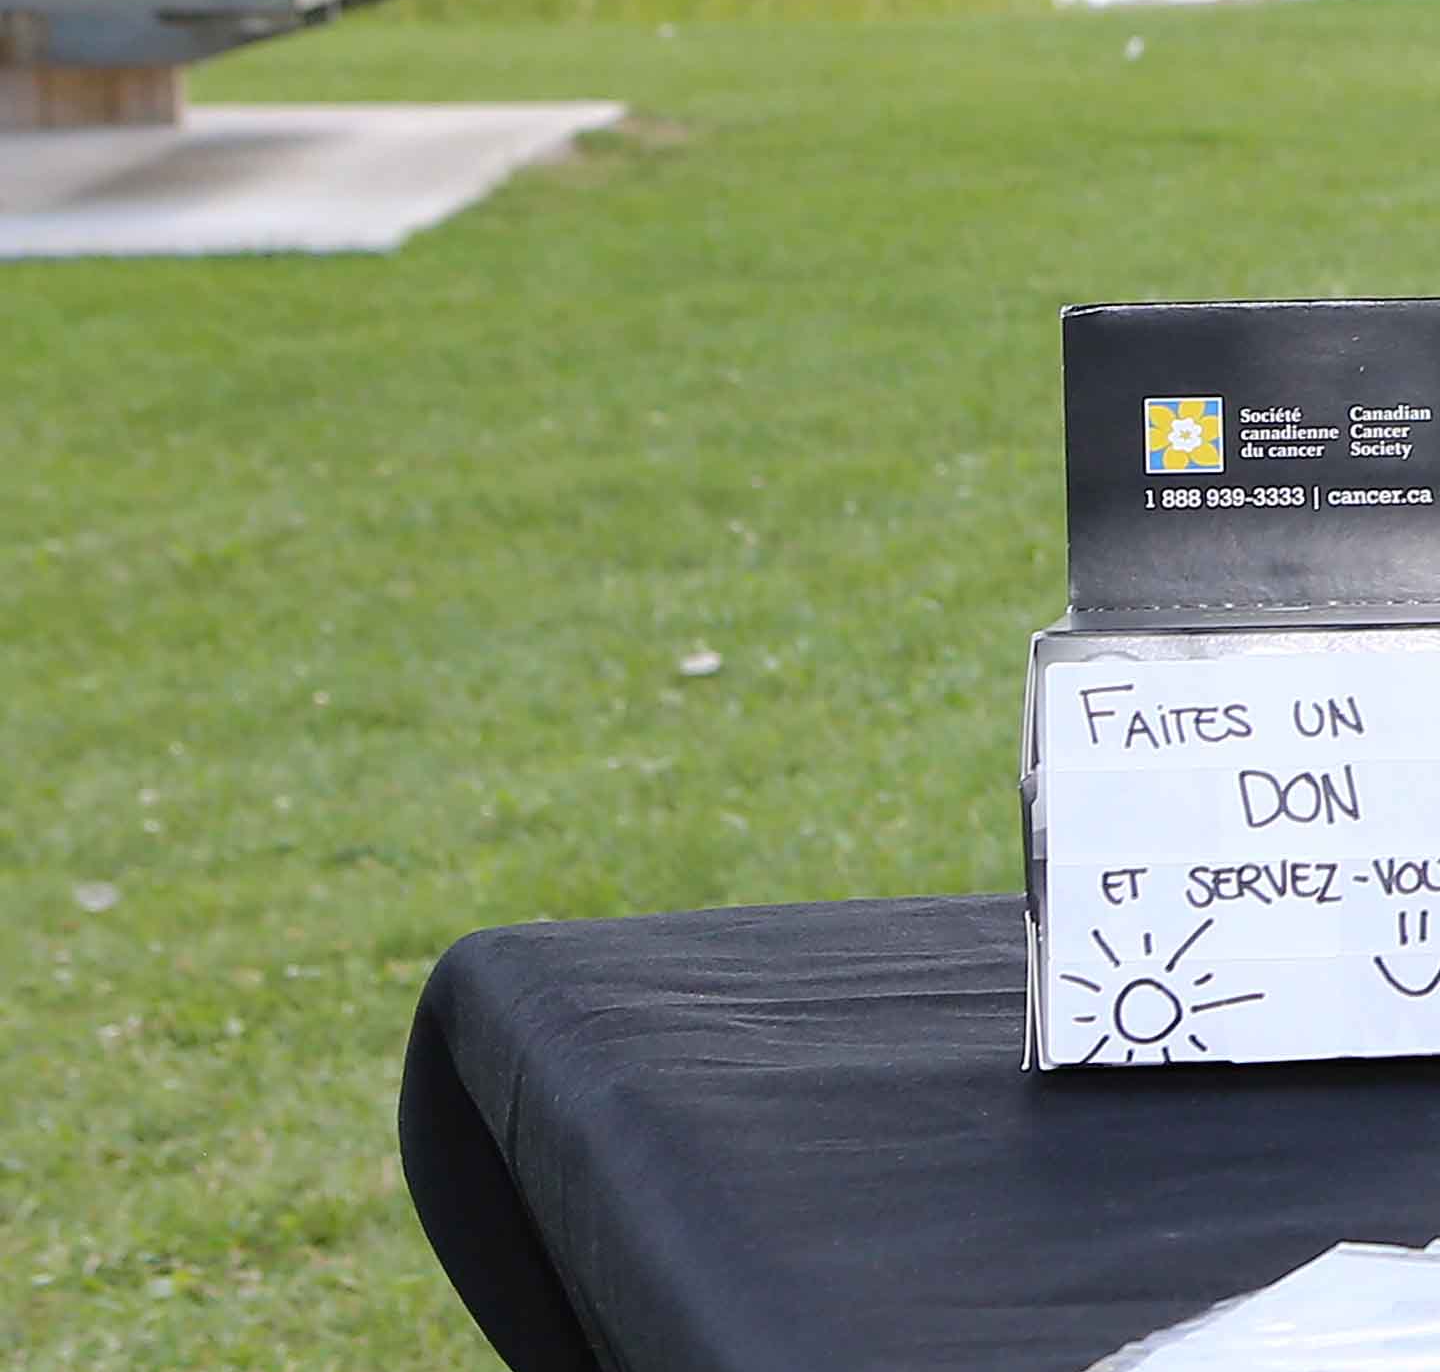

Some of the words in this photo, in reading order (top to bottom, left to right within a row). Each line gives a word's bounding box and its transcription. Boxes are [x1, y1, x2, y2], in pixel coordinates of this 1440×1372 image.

[1240, 408, 1302, 424] Société
[1350, 405, 1431, 422] Canadian
[1240, 425, 1340, 441] canadienne
[1350, 424, 1411, 440] Cancer
[1241, 442, 1264, 459] du
[1268, 444, 1325, 458] cancer
[1350, 441, 1413, 460] Society
[1145, 489, 1156, 509] 1
[1161, 488, 1202, 508] 888
[1206, 486, 1305, 507] 939-3333
[1327, 487, 1433, 507] cancer.ca
[1293, 696, 1364, 738] UN
[1239, 764, 1361, 828] DON
[1101, 867, 1148, 905] ET
